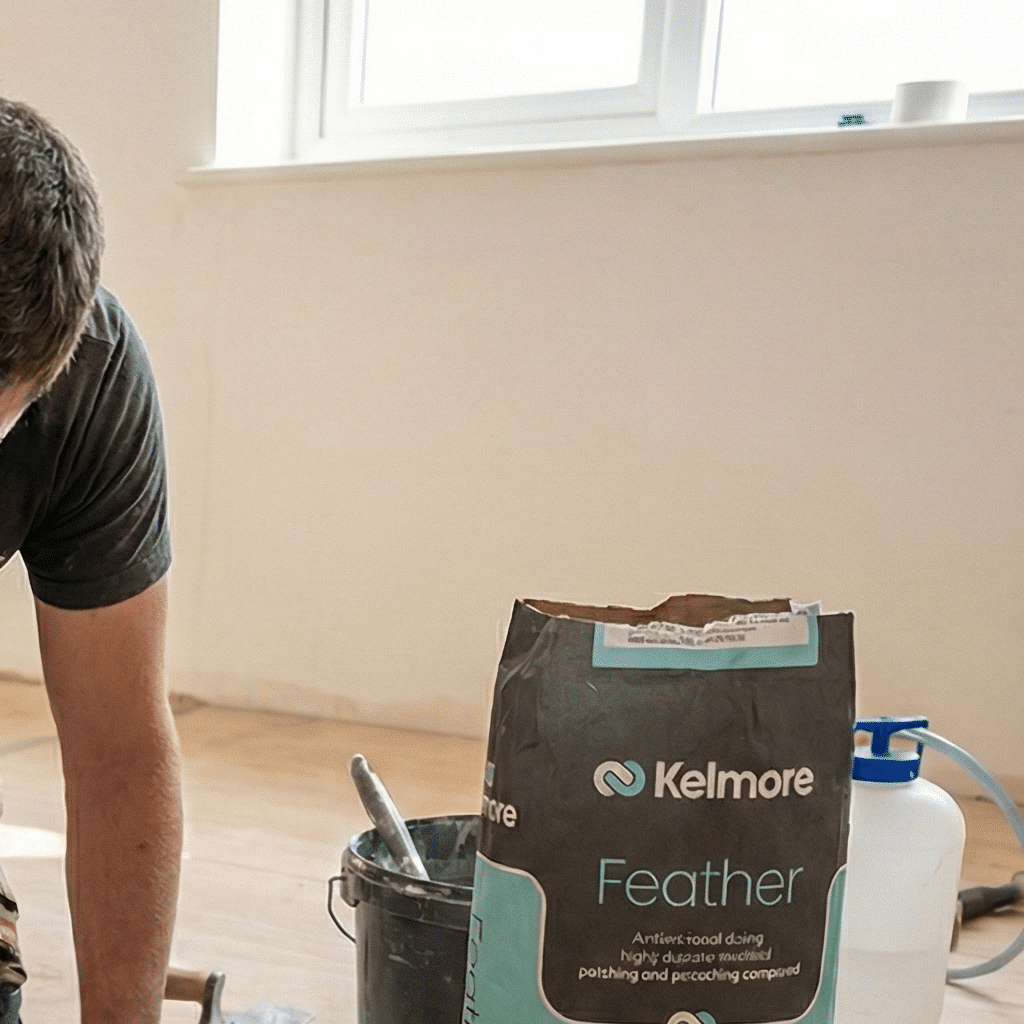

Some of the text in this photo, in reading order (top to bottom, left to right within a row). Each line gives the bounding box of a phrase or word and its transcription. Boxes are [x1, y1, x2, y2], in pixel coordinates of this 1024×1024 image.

[654, 760, 814, 799] Kelmore
[598, 858, 804, 907] Feather
[641, 967, 669, 982] and
